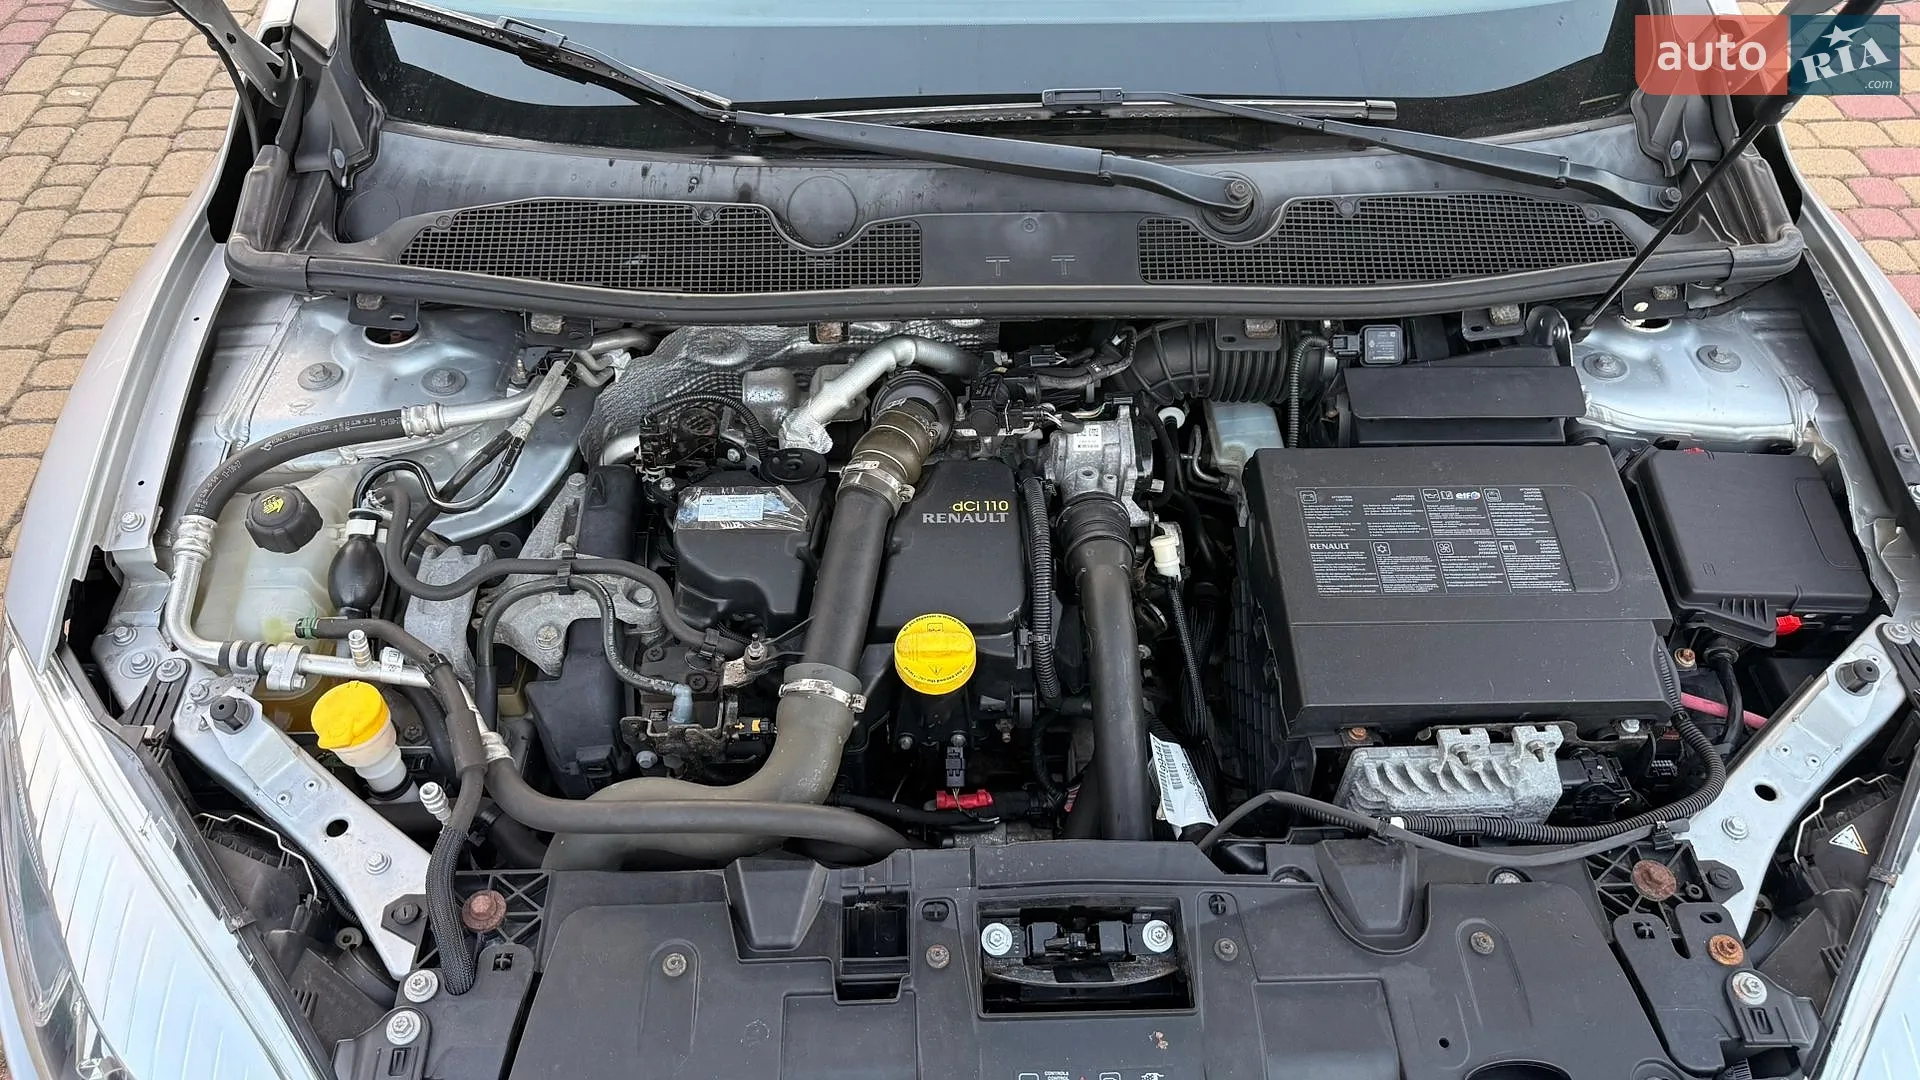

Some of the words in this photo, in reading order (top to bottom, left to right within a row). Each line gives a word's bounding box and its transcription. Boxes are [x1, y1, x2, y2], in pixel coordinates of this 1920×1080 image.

[952, 501, 980, 512] dCi
[983, 500, 1009, 512] 110
[922, 512, 1009, 523] RENAULT
